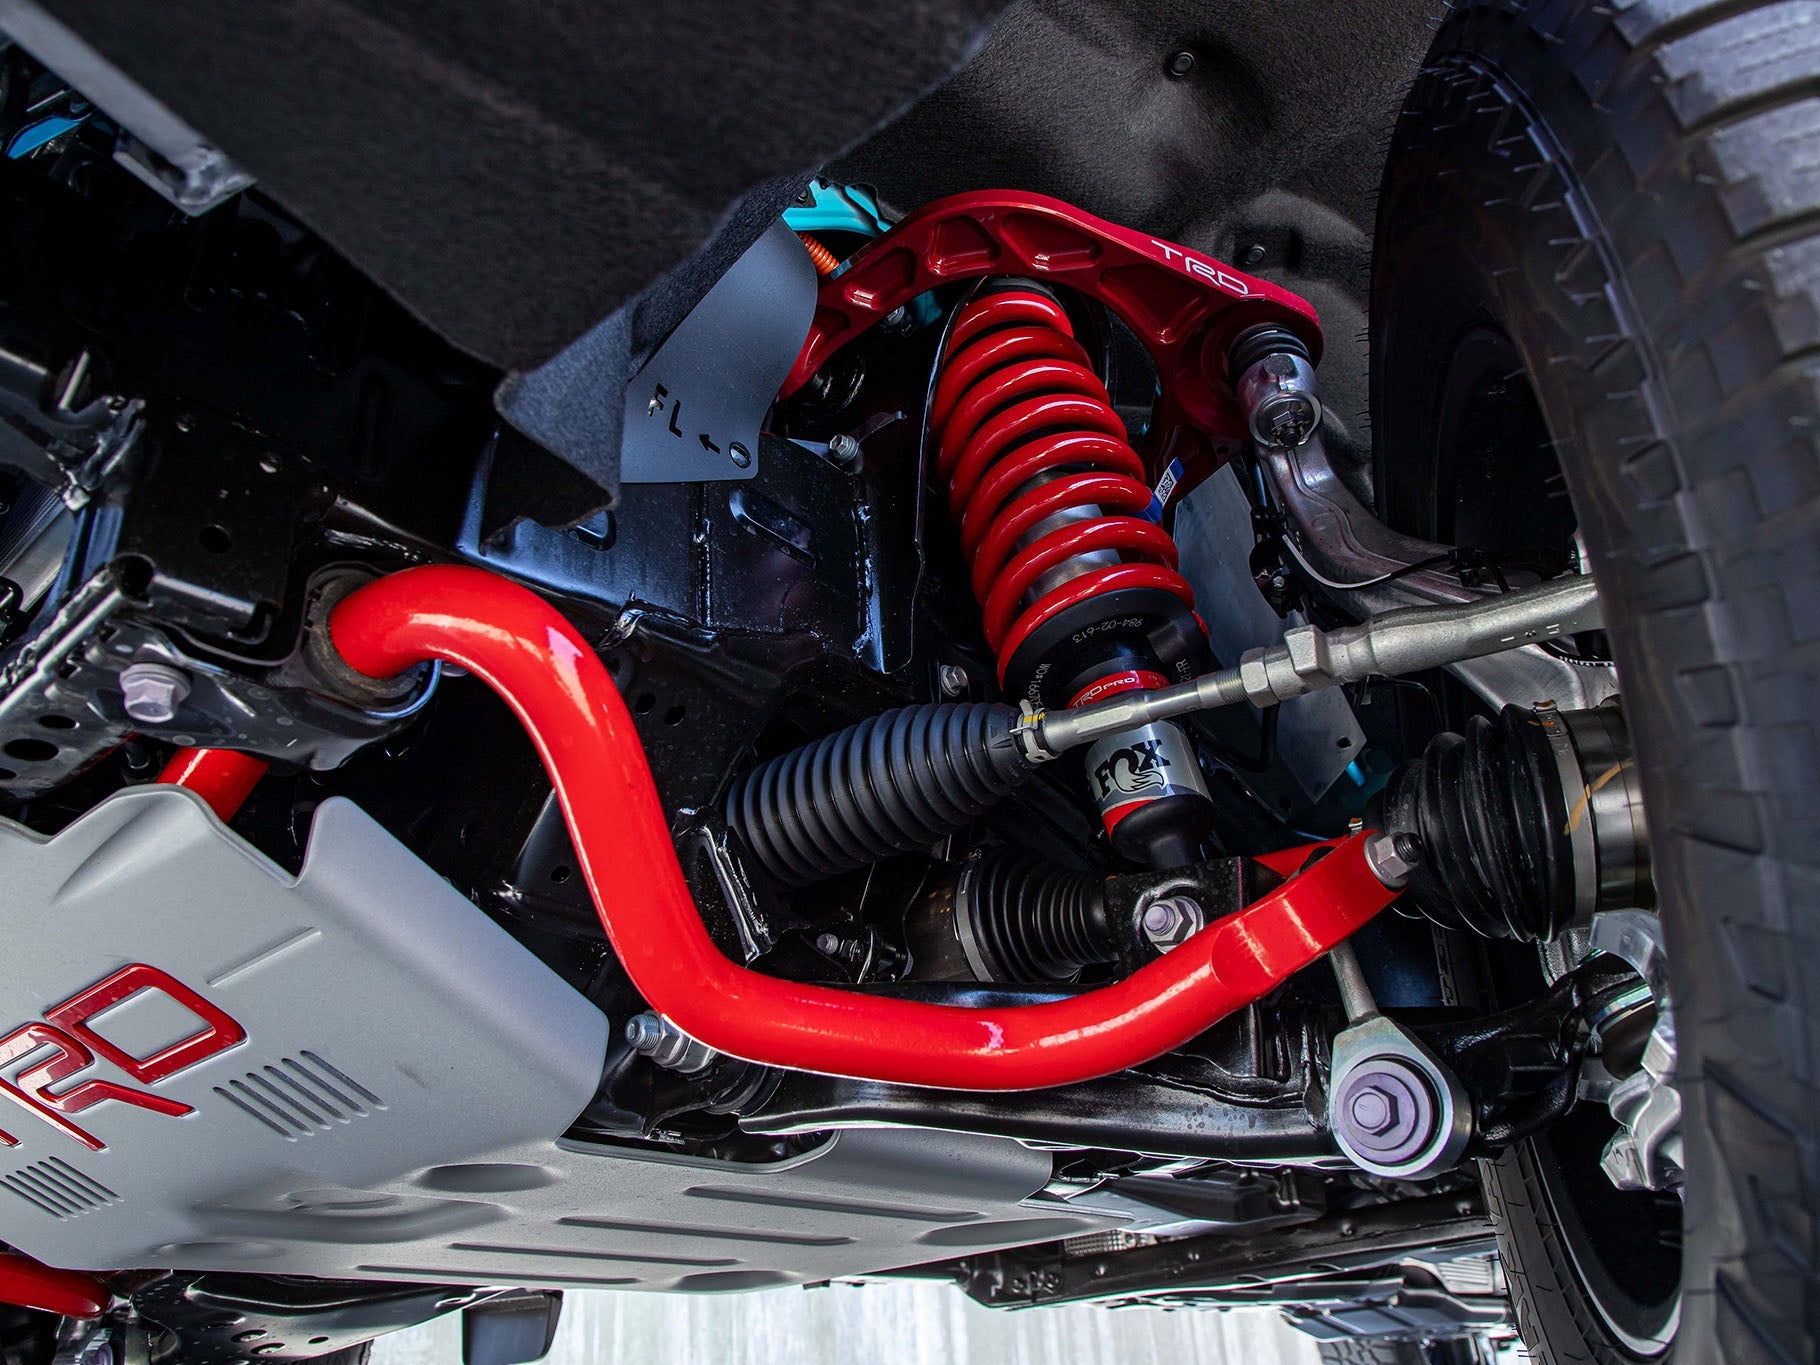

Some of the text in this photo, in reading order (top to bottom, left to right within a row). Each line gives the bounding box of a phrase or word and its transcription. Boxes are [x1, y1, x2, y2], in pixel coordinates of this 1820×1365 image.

[1151, 239, 1249, 296] TRD
[1094, 738, 1172, 799] FOX
[0, 962, 248, 1152] RD
